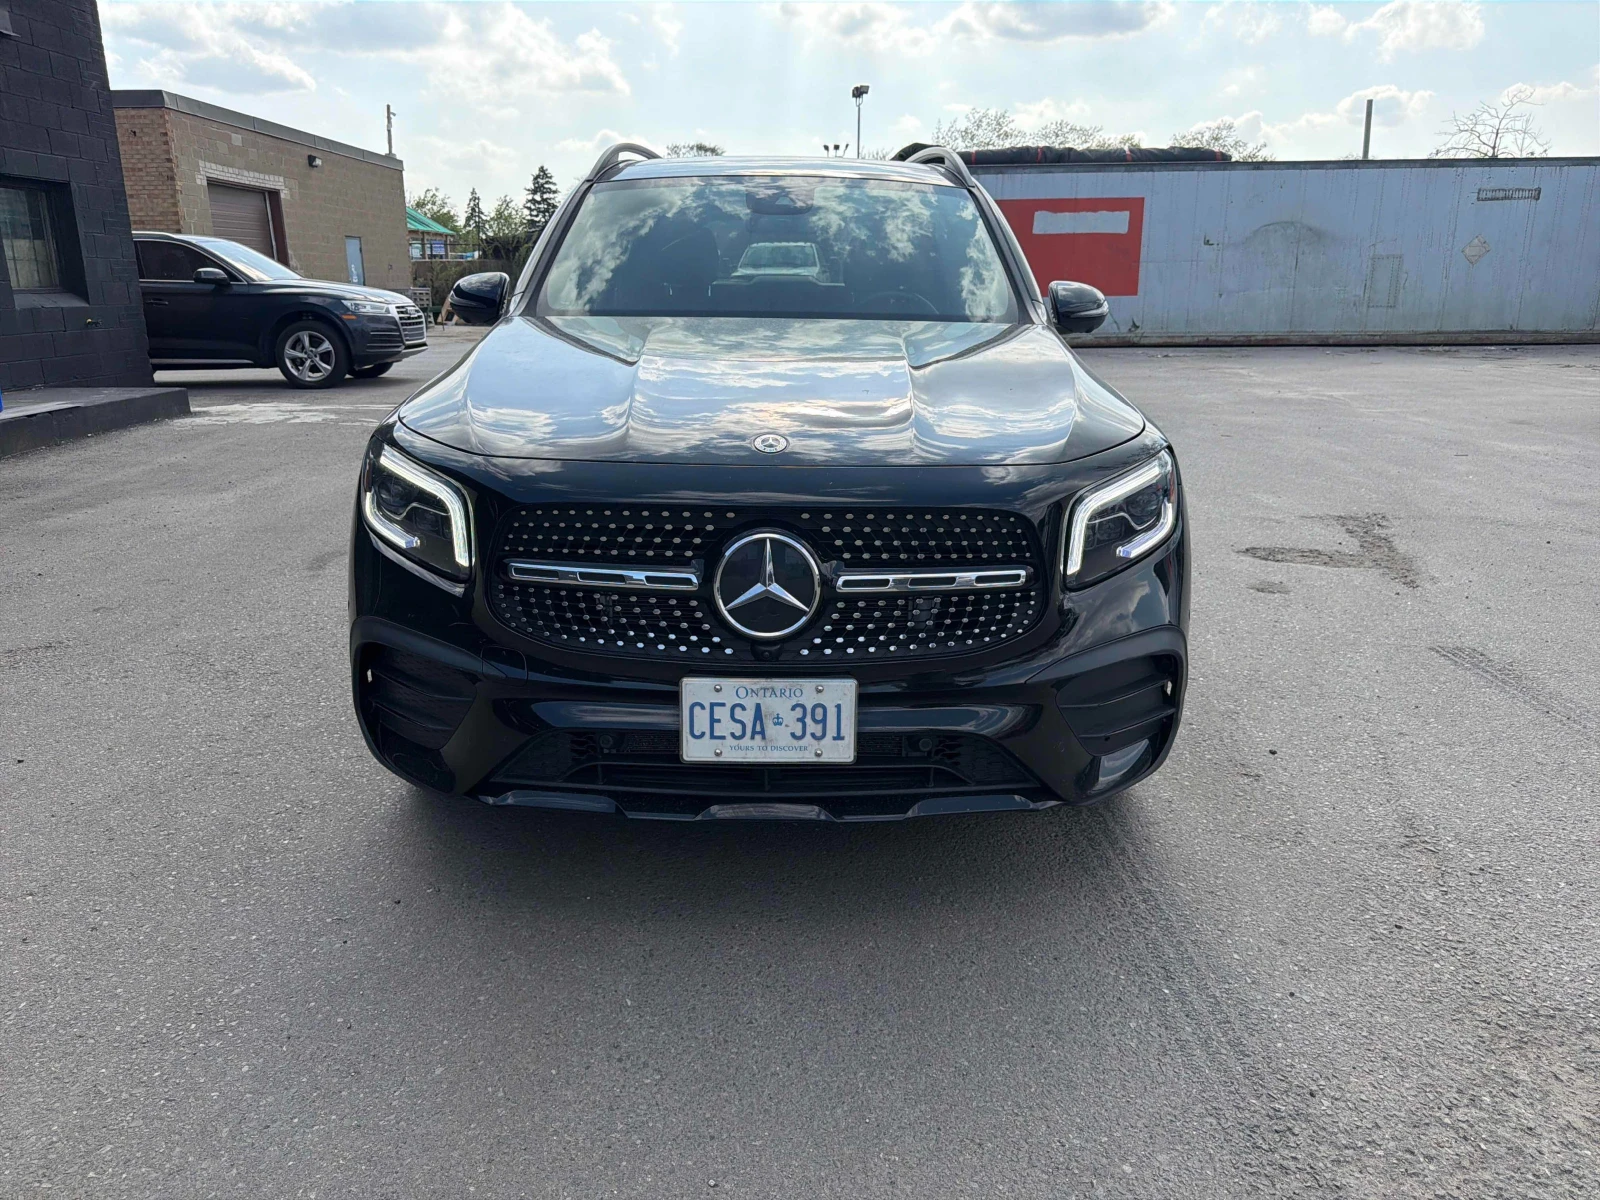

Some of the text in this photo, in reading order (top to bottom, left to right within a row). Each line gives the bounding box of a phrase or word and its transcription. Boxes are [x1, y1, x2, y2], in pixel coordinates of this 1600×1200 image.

[735, 686, 804, 700] ONTARIO
[688, 701, 846, 741] CESA 391
[729, 744, 755, 752] YOURS
